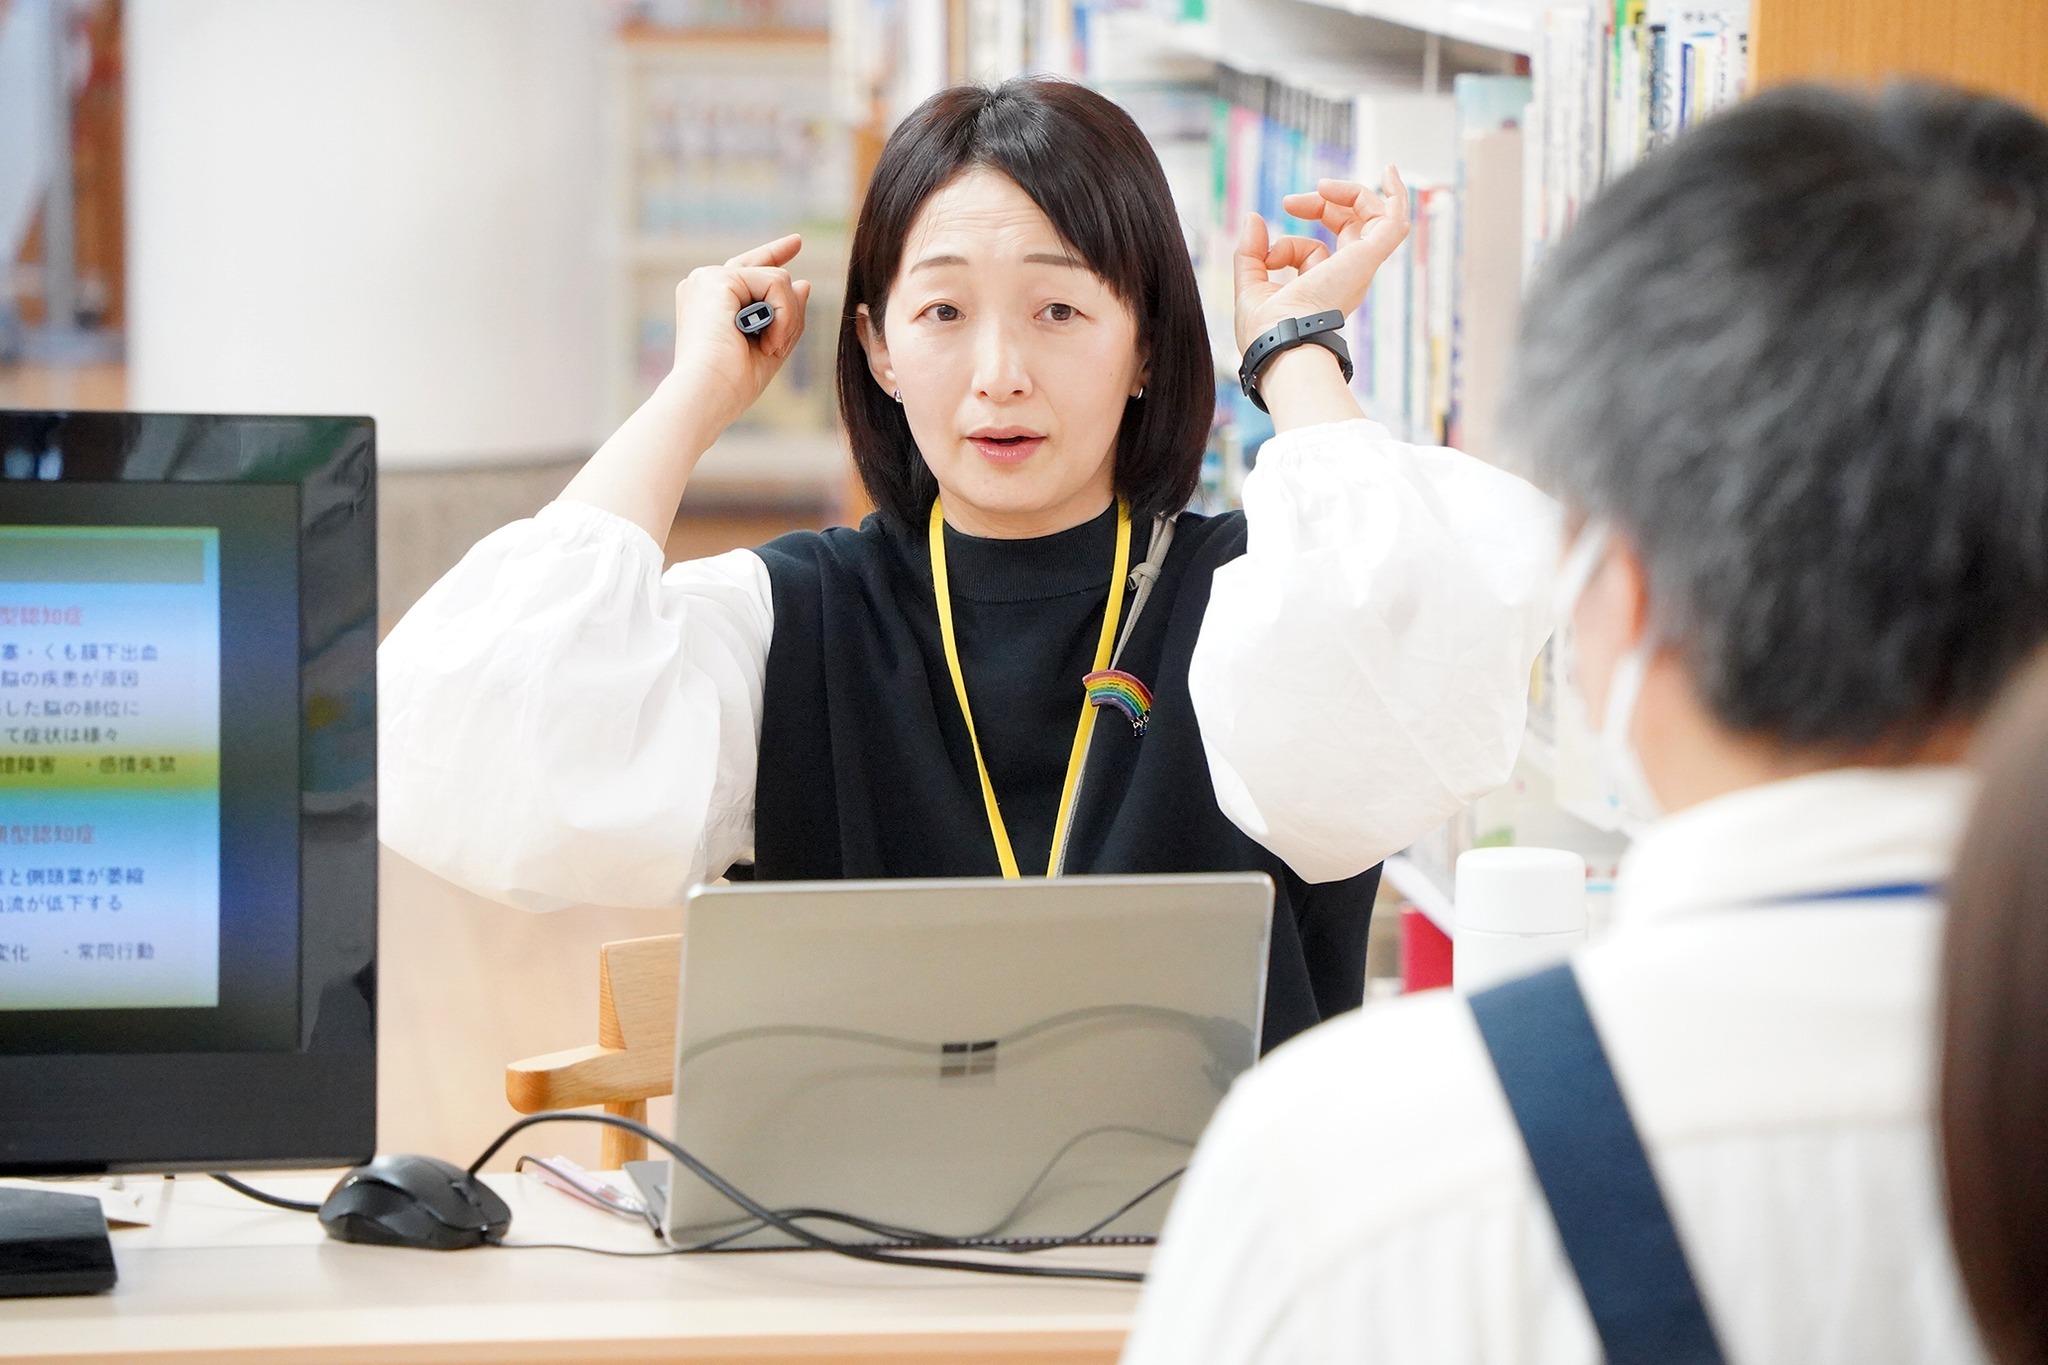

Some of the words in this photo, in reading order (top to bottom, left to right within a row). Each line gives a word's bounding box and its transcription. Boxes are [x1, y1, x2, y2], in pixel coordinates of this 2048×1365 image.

[0, 606, 81, 626] 型認知症
[2, 643, 158, 661] 塞・くも膜下出血
[2, 670, 139, 688] 脳の疾患が原因
[0, 699, 140, 717] した脳の部位に
[5, 727, 118, 744] て症状は様々
[0, 867, 144, 886] と側頭葉が萎縮
[0, 895, 122, 913] 流が低下する
